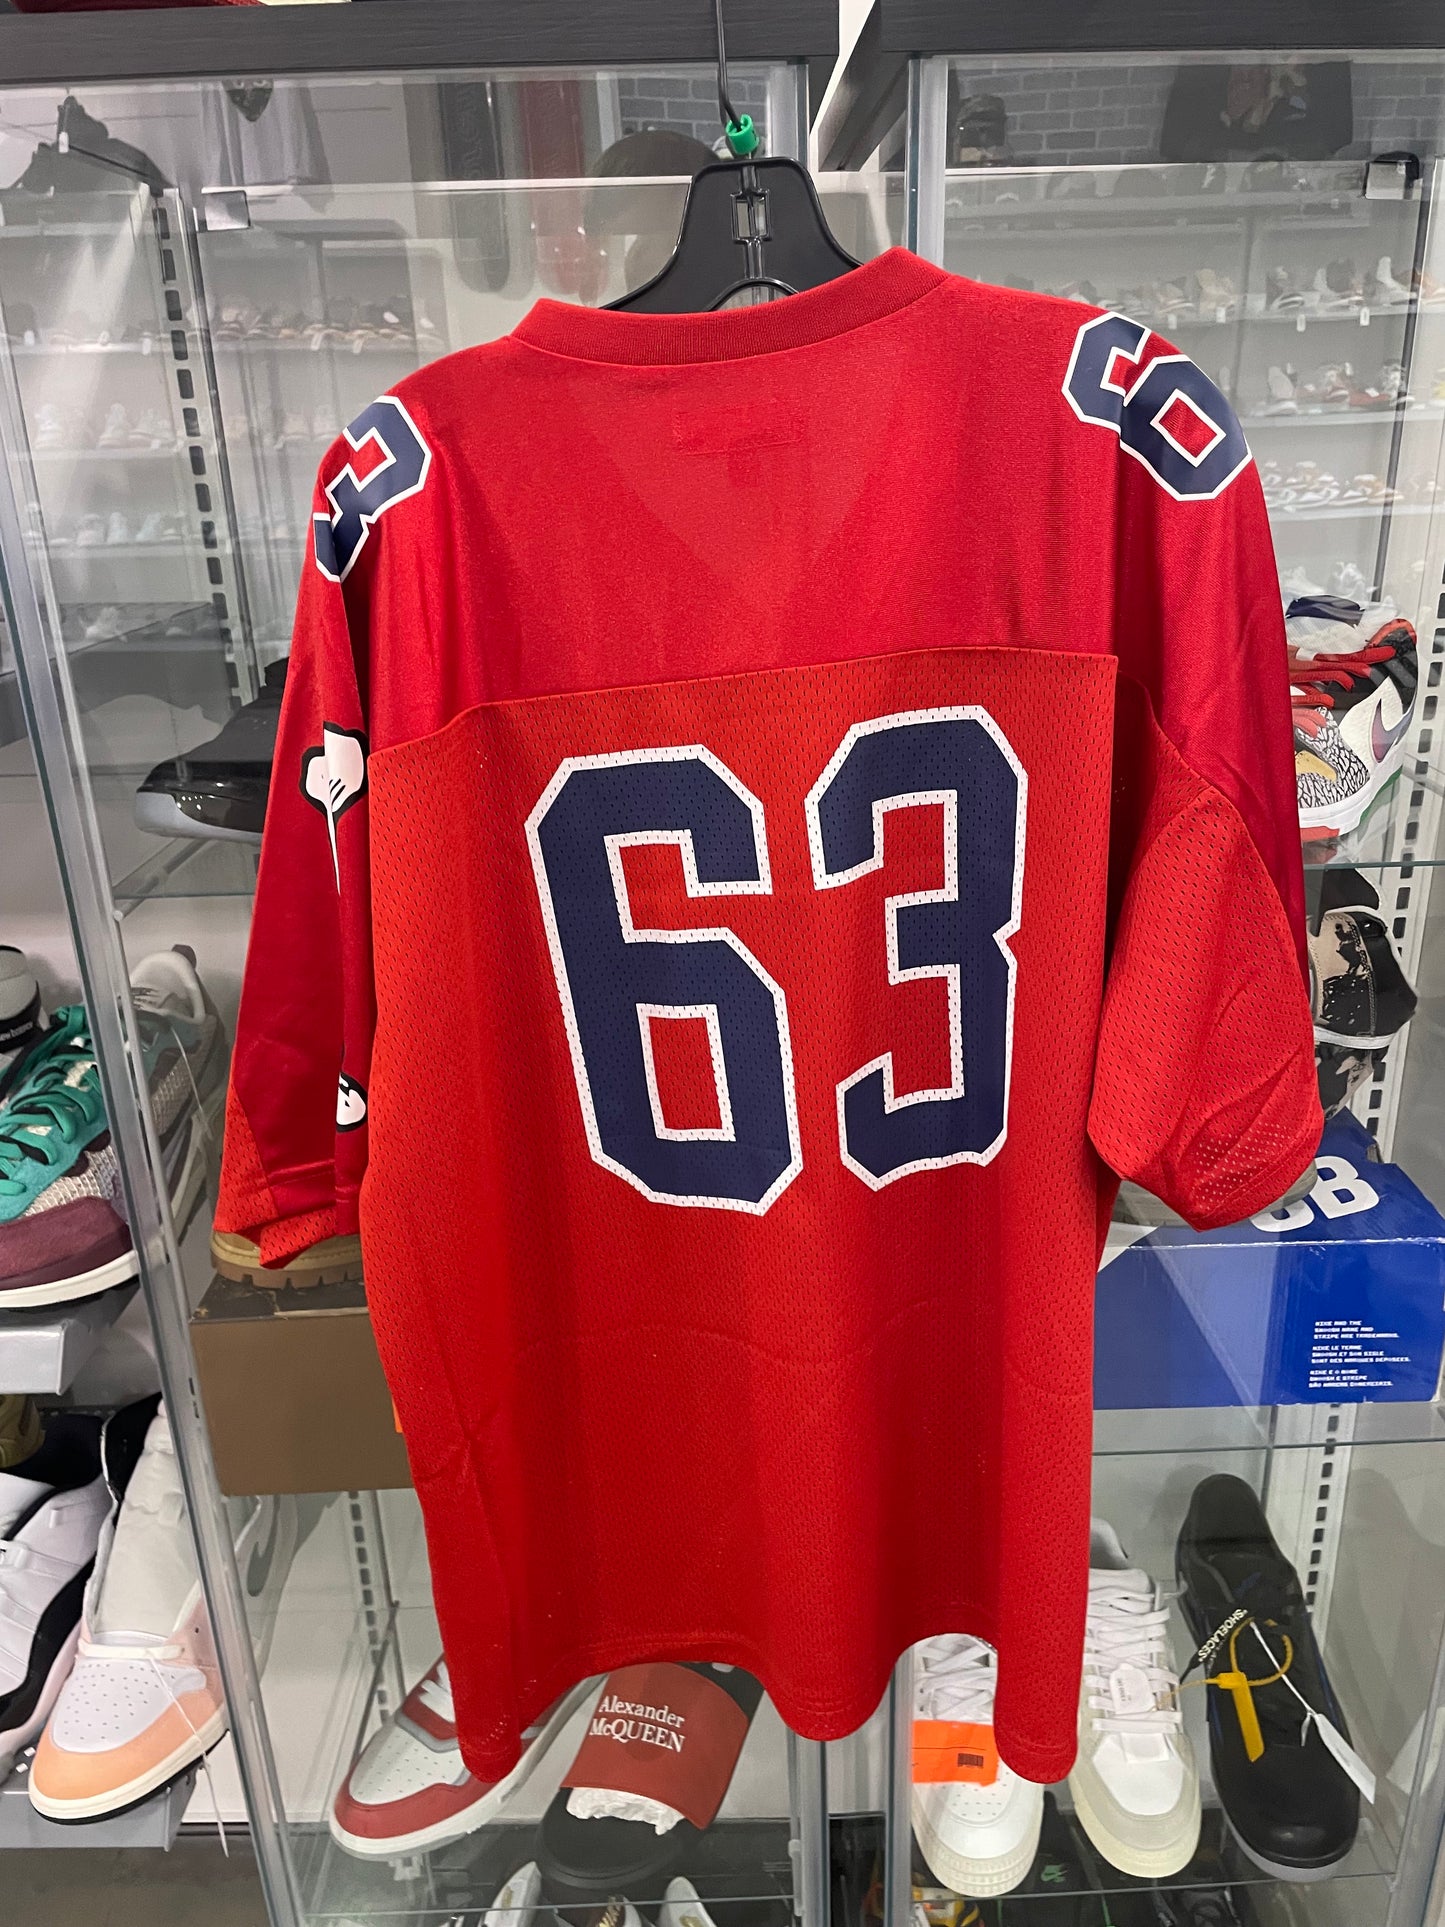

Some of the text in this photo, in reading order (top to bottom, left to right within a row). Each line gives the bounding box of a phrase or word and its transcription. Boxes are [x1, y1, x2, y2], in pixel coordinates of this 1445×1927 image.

[1061, 311, 1253, 501] 6
[525, 704, 1029, 1217] 63
[588, 1717, 687, 1753] McQUEEN
[598, 1695, 686, 1729] Alexander
